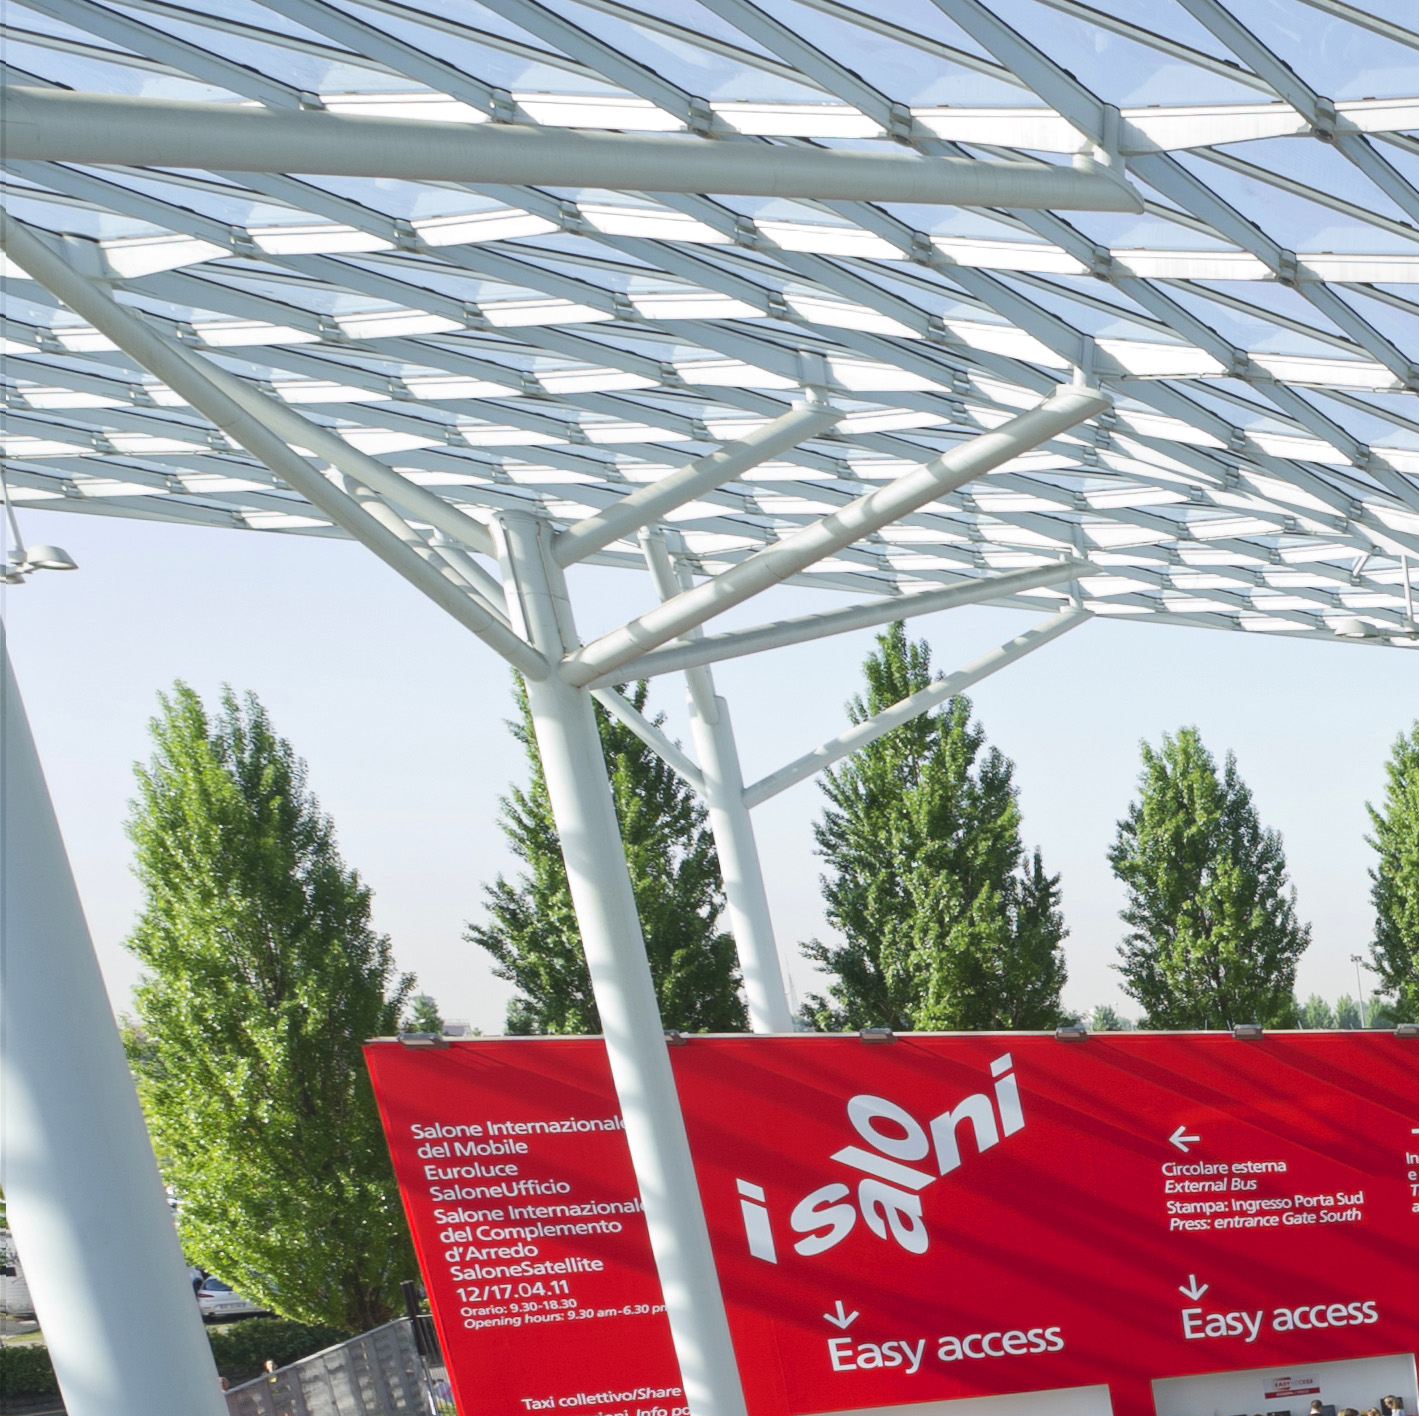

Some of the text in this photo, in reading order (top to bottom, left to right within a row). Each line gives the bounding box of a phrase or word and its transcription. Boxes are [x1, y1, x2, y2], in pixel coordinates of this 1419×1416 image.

[411, 1120, 482, 1139] Salone
[417, 1138, 528, 1159] del Mobile
[736, 1053, 1025, 1264] isaloni
[424, 1161, 518, 1180] Euroluce
[1162, 1159, 1286, 1176] Circolare esterna
[1408, 1170, 1417, 1180] e
[429, 1178, 570, 1201] SaloneUfficio
[1165, 1176, 1257, 1193] External Bus
[434, 1205, 504, 1224] Salone
[1167, 1191, 1364, 1216] Stampa: Ingresso Porta Sud
[1170, 1208, 1361, 1231] Press: entrance Gate South
[440, 1219, 622, 1244] del Complemento
[445, 1242, 538, 1262] d'Arredo
[450, 1256, 604, 1281] SaloneSatellite
[456, 1280, 569, 1302] 12/17.04.11
[461, 1298, 577, 1317] Orario: 9.30-18.30
[464, 1316, 518, 1331] Opening
[522, 1312, 564, 1325] hours:
[567, 1309, 594, 1321] 9.30
[597, 1304, 649, 1319] am-6.30
[1181, 1300, 1378, 1343] Easy access
[828, 1326, 1064, 1374] Easy access
[522, 1384, 682, 1411] Taxi collettivo/Share
